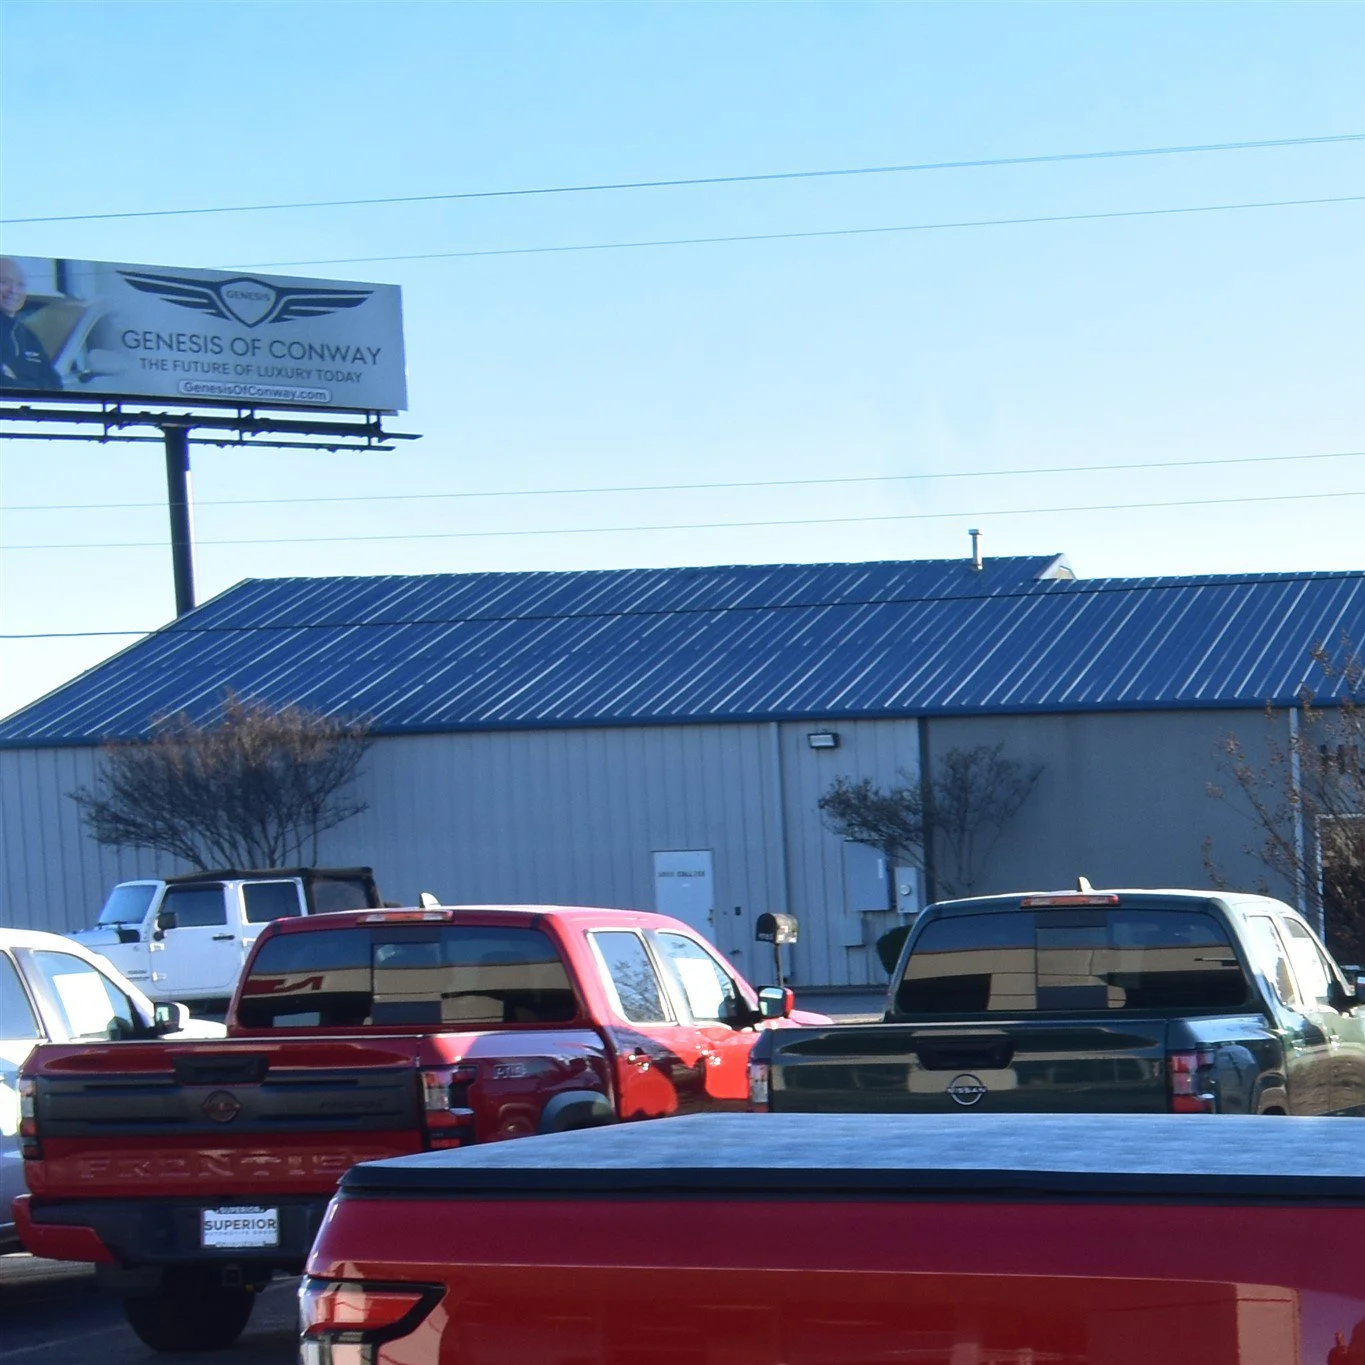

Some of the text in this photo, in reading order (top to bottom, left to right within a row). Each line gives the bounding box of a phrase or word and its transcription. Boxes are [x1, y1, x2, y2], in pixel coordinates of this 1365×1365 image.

[225, 289, 272, 301] GENESIS
[122, 329, 382, 365] GENESIS OF CONWAY
[139, 357, 362, 383] THE FUTURE OF LUXURY TODAY
[183, 381, 327, 401] GenesisOfConway.com
[78, 1149, 384, 1179] FRONTIE
[204, 1218, 277, 1231] SUPERIOR
